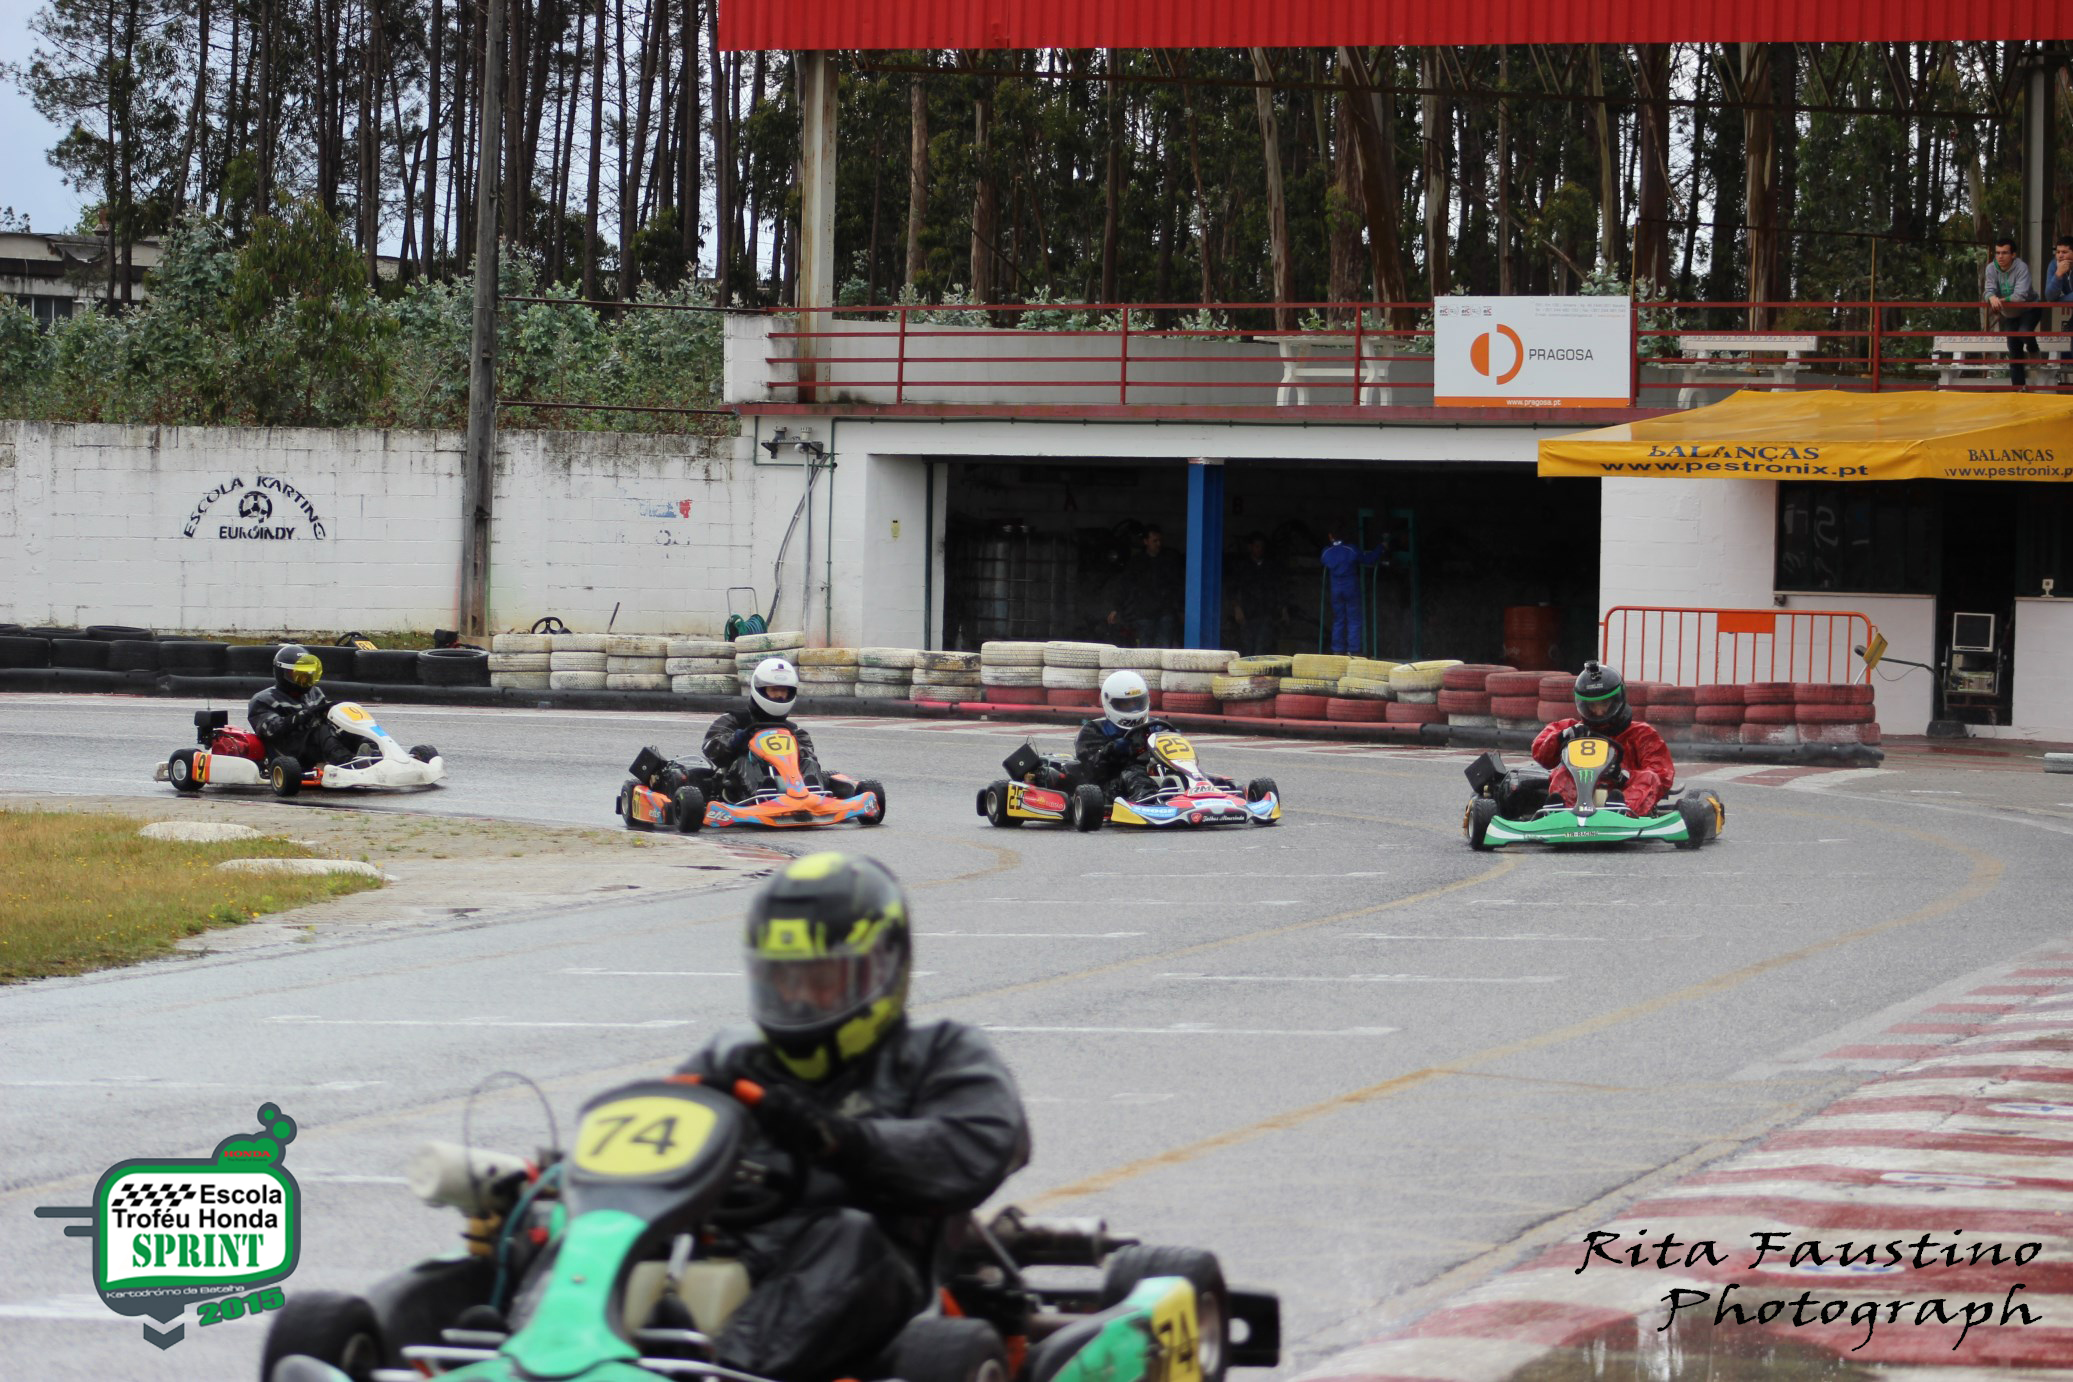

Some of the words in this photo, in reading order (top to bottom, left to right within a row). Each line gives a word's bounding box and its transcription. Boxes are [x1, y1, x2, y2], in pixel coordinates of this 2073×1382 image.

[1528, 348, 1594, 361] PRAGOSA
[1506, 399, 1562, 407] www.pragosa.pt
[1968, 448, 2055, 464] BALANÇAS
[1600, 460, 1869, 478] www.pestronix.pt
[184, 477, 244, 538] ESCOLA
[256, 475, 326, 540] KARTING
[219, 525, 296, 540] EUROINDY
[765, 735, 792, 752] 67
[1158, 737, 1190, 755] 25
[1580, 740, 1596, 756] 8
[197, 753, 207, 780] 9
[588, 1112, 680, 1157] 74
